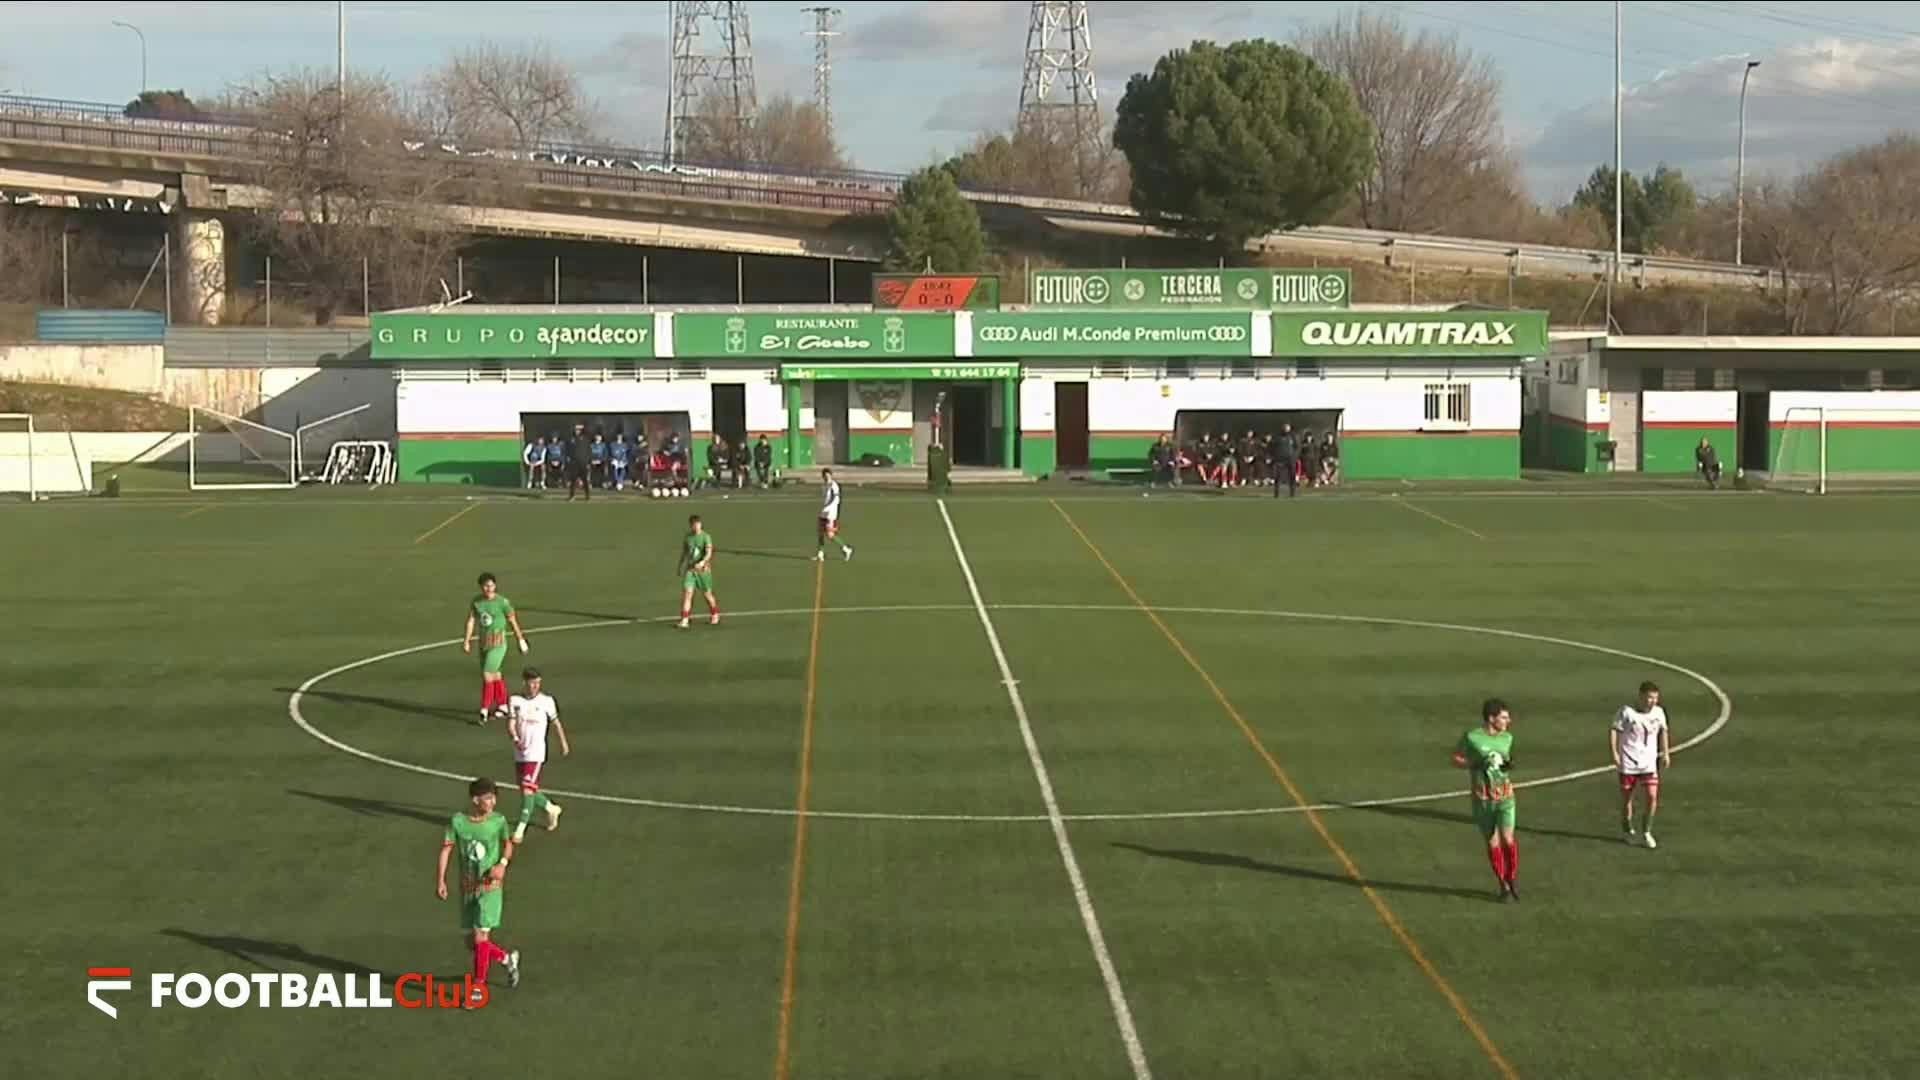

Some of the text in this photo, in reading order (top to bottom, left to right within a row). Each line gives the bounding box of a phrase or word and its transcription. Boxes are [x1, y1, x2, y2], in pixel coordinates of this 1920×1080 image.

[1160, 274, 1222, 295] TERCERA
[919, 293, 928, 305] 0
[944, 293, 954, 305] 0
[775, 318, 859, 329] RESTAURANTE
[378, 323, 648, 355] GRUPO afandecor
[1019, 326, 1207, 341] Audi M.Conde Premium
[1301, 320, 1517, 345] QUAMTRAX
[760, 334, 791, 350] El
